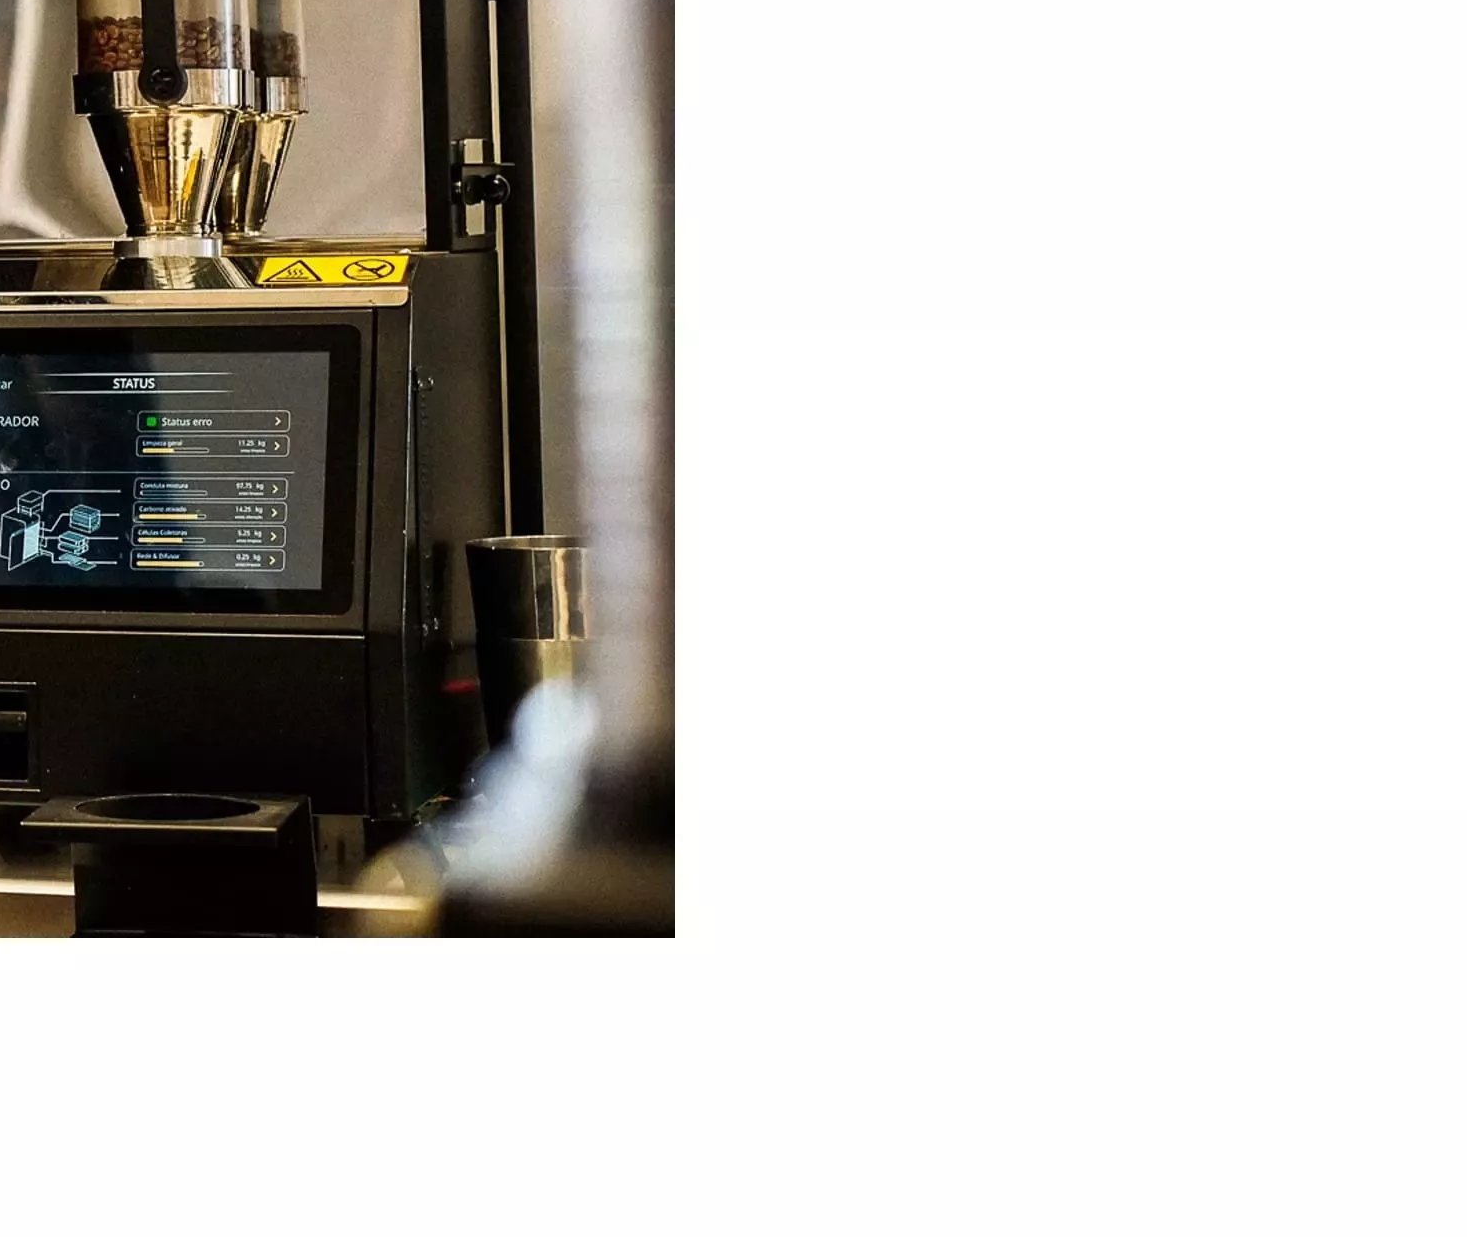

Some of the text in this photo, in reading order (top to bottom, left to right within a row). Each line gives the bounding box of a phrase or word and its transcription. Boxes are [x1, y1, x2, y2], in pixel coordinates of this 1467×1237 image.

[112, 377, 156, 390] STATUS
[161, 417, 213, 427] Status erro
[257, 439, 266, 448] kg
[256, 482, 264, 491] kg
[255, 506, 263, 514] kg
[254, 529, 262, 538] kg
[252, 553, 261, 562] kg
